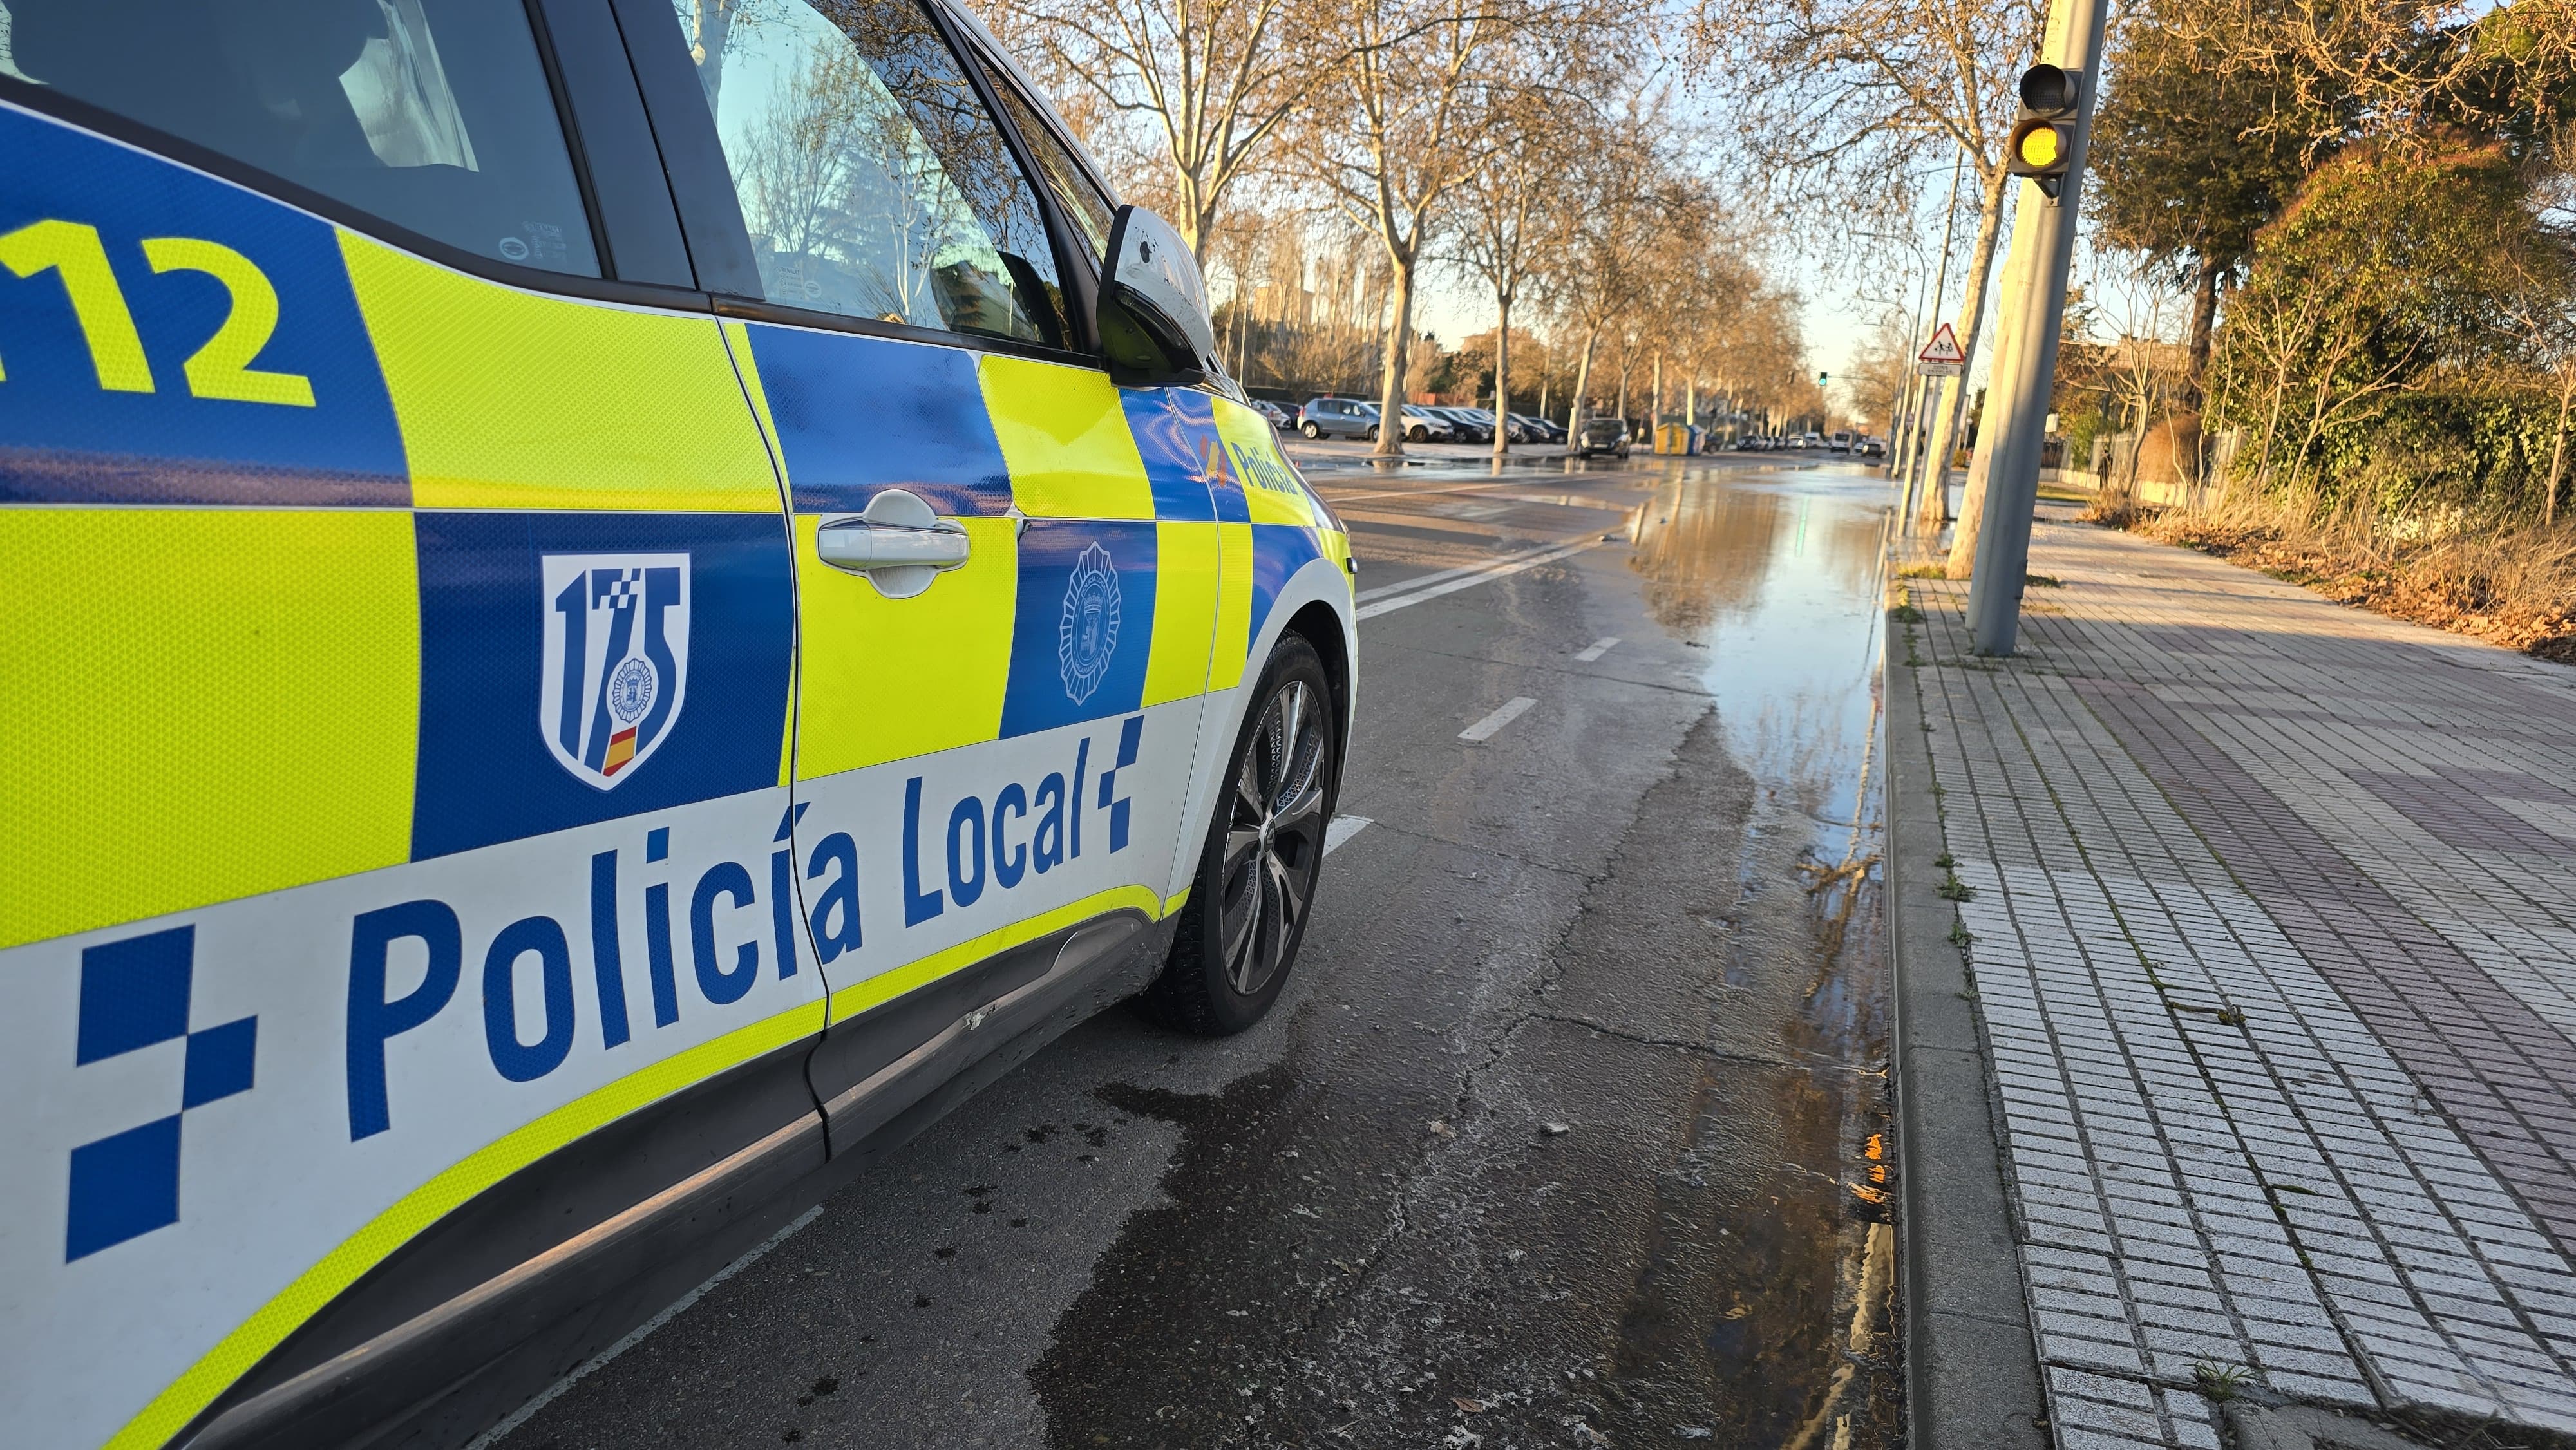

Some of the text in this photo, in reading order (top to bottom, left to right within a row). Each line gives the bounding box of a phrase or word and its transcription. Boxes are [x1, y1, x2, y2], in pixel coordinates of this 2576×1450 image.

[0, 219, 316, 407] 12
[1231, 442, 1299, 496] Policía
[556, 567, 681, 775] 175
[346, 737, 1091, 1143] Policía Local
